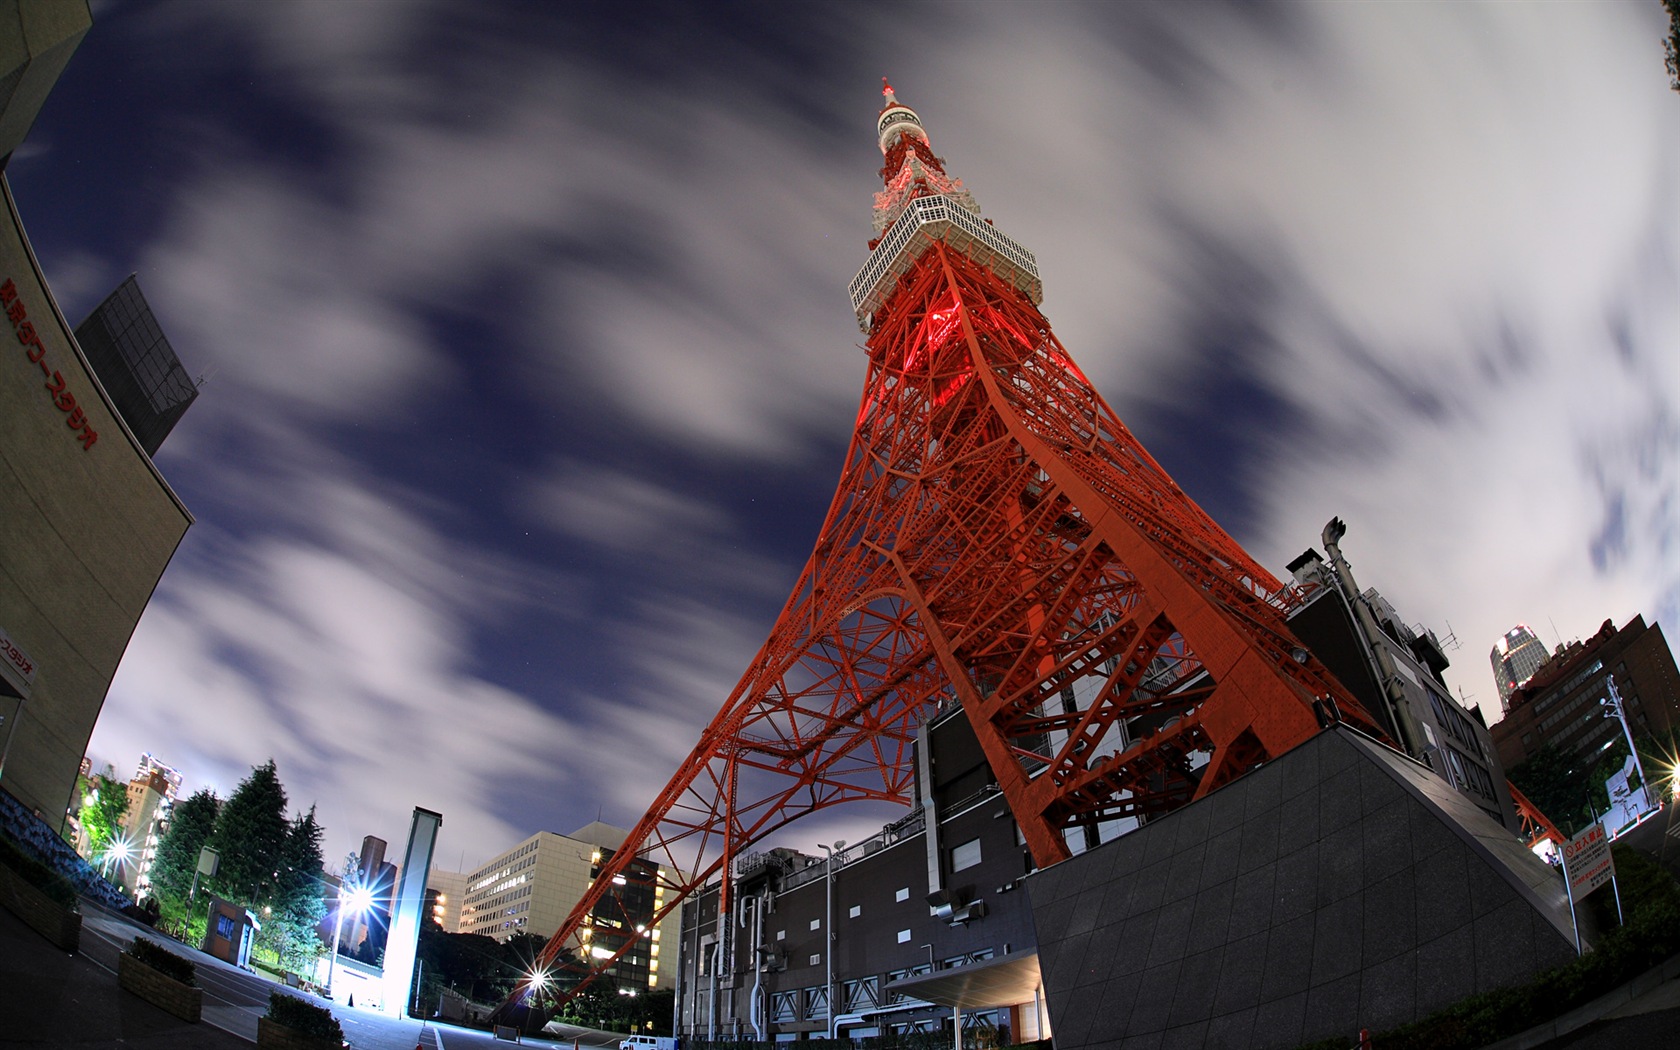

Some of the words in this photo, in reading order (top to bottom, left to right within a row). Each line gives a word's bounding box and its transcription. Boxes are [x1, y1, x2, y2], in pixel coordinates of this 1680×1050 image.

[0, 277, 98, 450] 東京タワースタジオ
